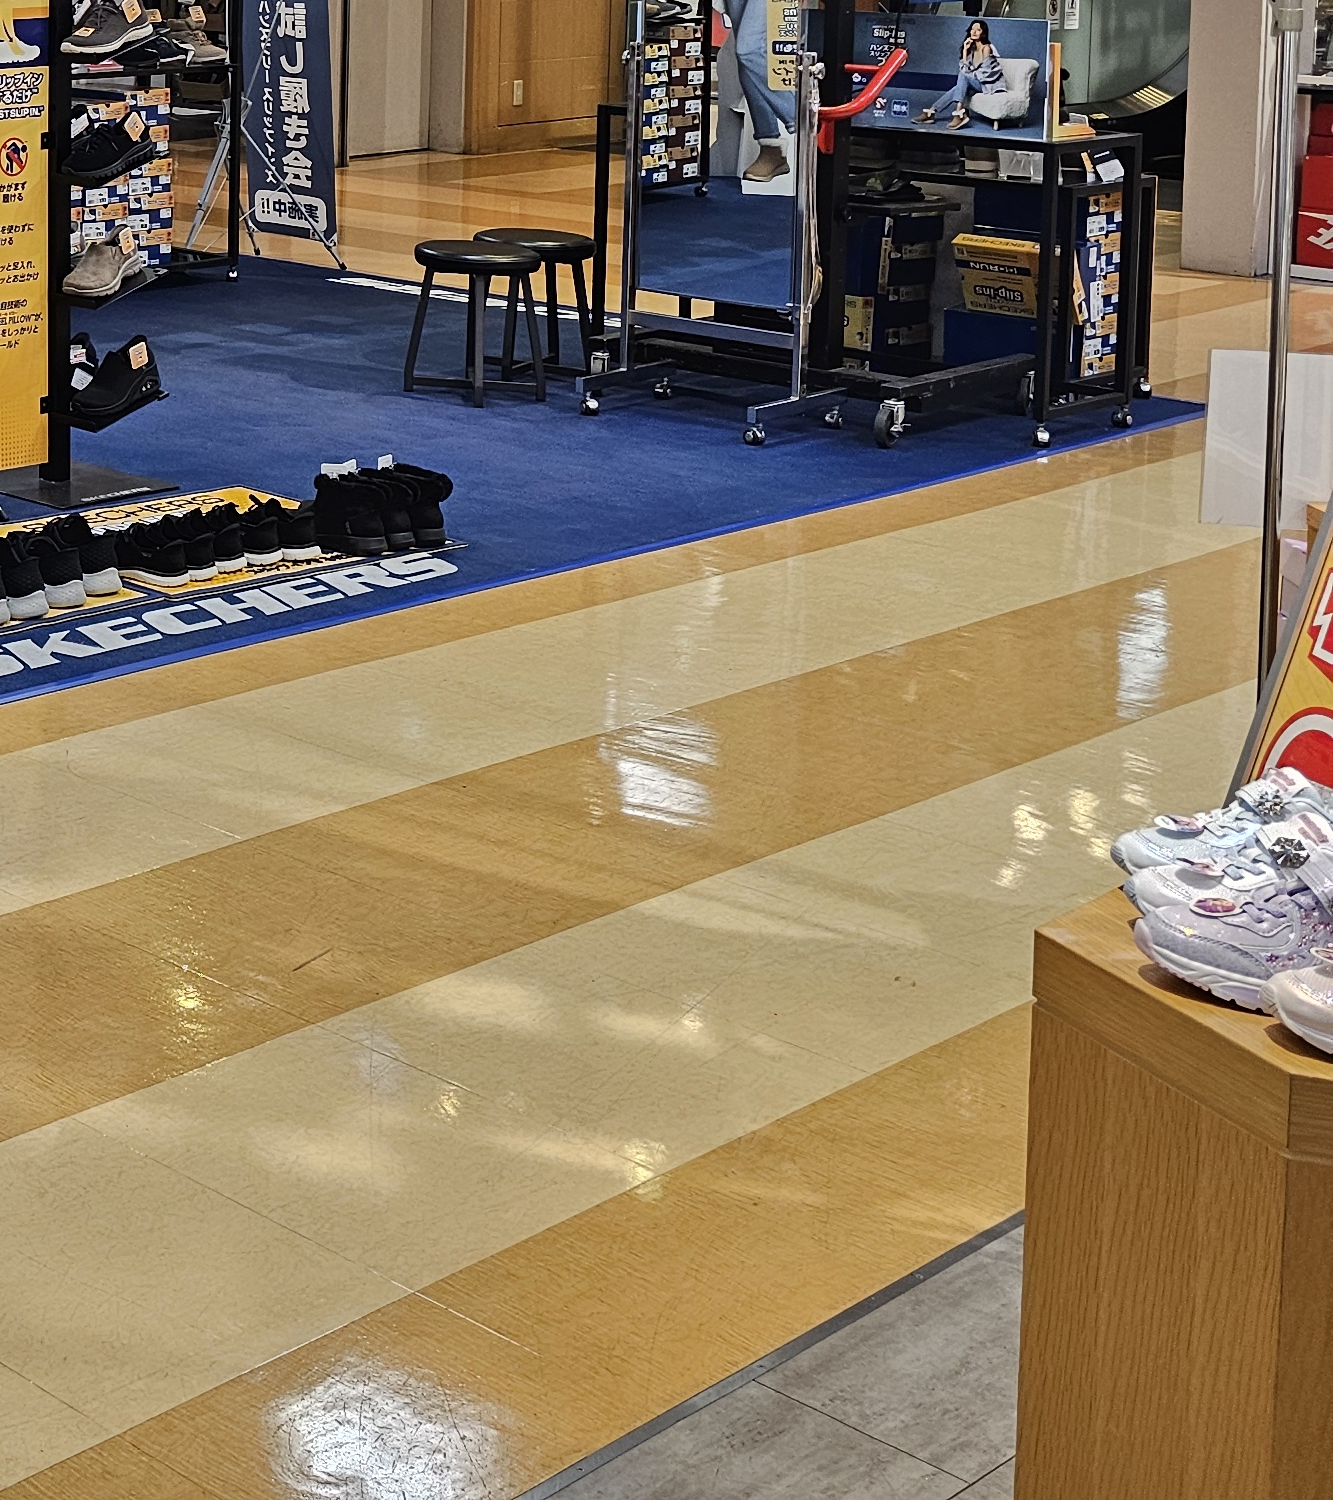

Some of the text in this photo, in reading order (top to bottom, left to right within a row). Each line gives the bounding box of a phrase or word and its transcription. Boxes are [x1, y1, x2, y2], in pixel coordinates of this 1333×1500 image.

[10, 107, 29, 120] SLIP
[0, 181, 27, 193] かがまず
[974, 285, 1023, 302] Slip-ins
[81, 486, 151, 502] SKECHERS
